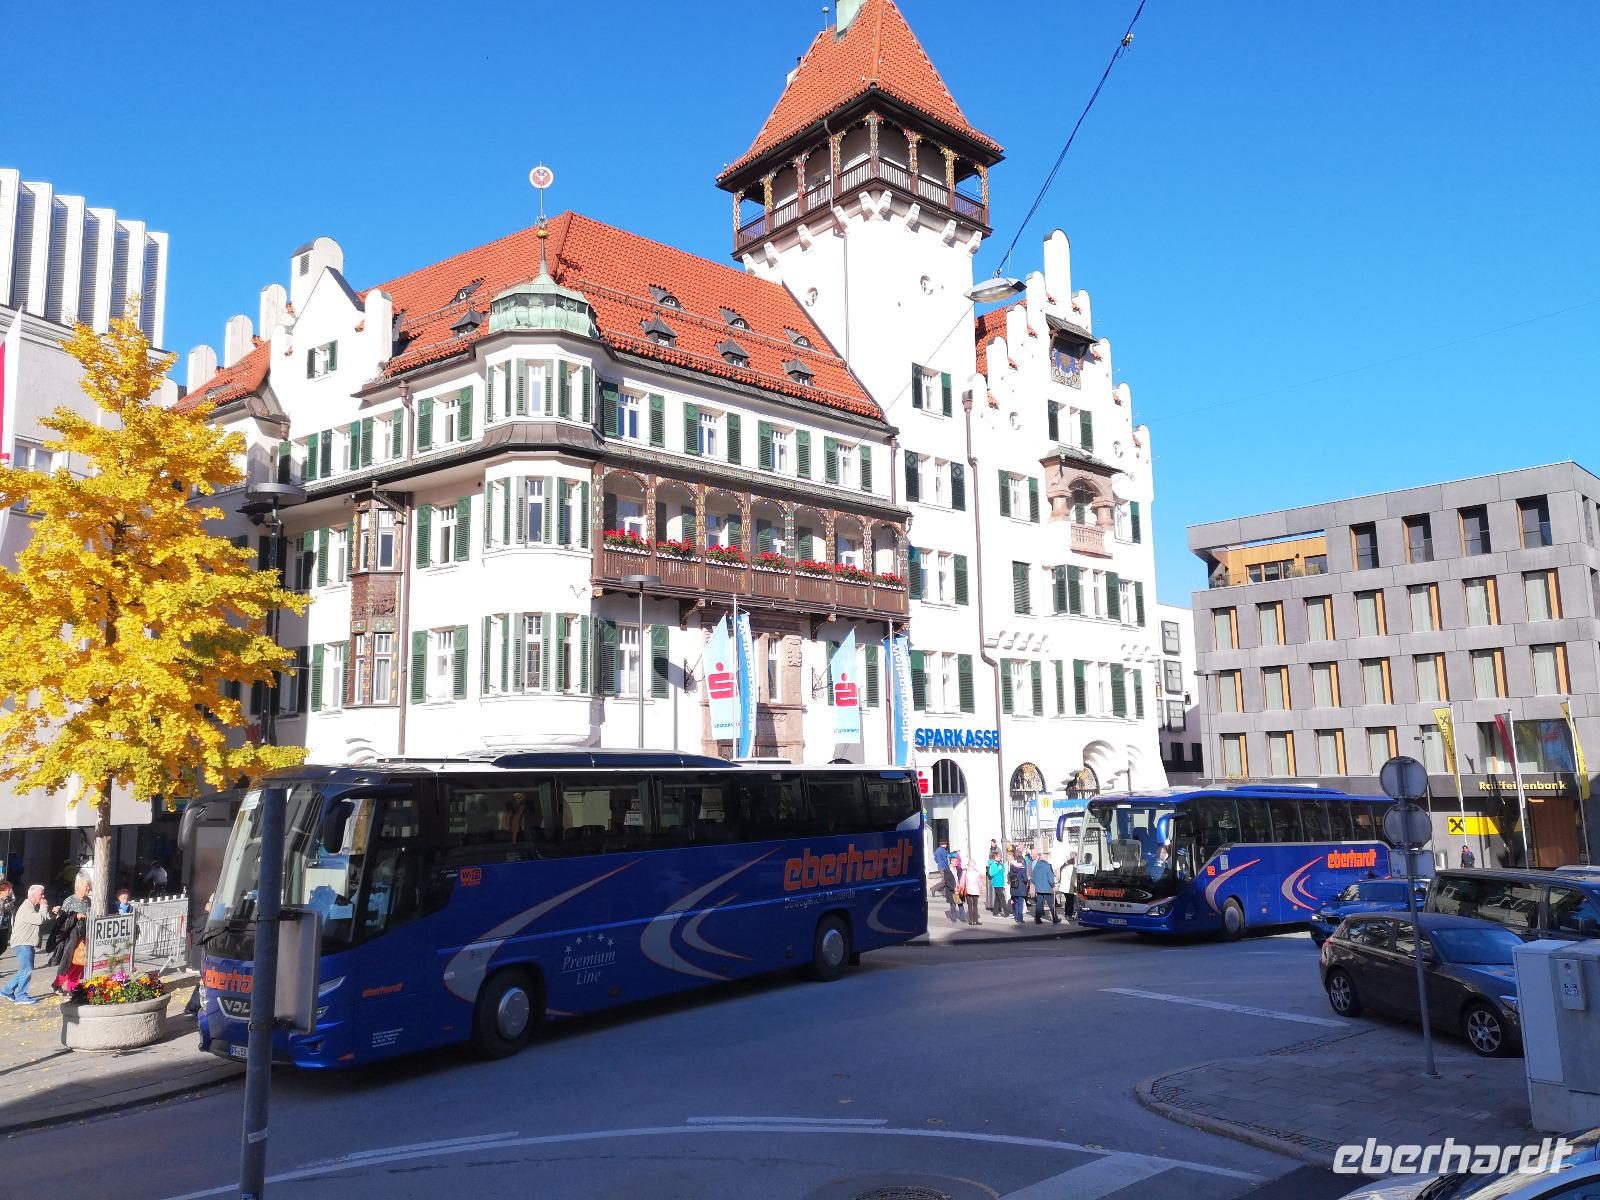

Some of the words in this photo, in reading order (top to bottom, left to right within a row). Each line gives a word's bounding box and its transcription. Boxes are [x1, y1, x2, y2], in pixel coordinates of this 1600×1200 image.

[915, 728, 999, 748] SPARKASSE
[1478, 780, 1567, 791] Raiffeienbank
[783, 838, 913, 891] eberhardt
[1327, 849, 1377, 868] eberhardt
[96, 919, 131, 940] RIEDEL
[562, 951, 616, 970] Premium
[204, 967, 256, 993] eberha
[576, 970, 601, 985] Line
[223, 999, 251, 1014] VDL
